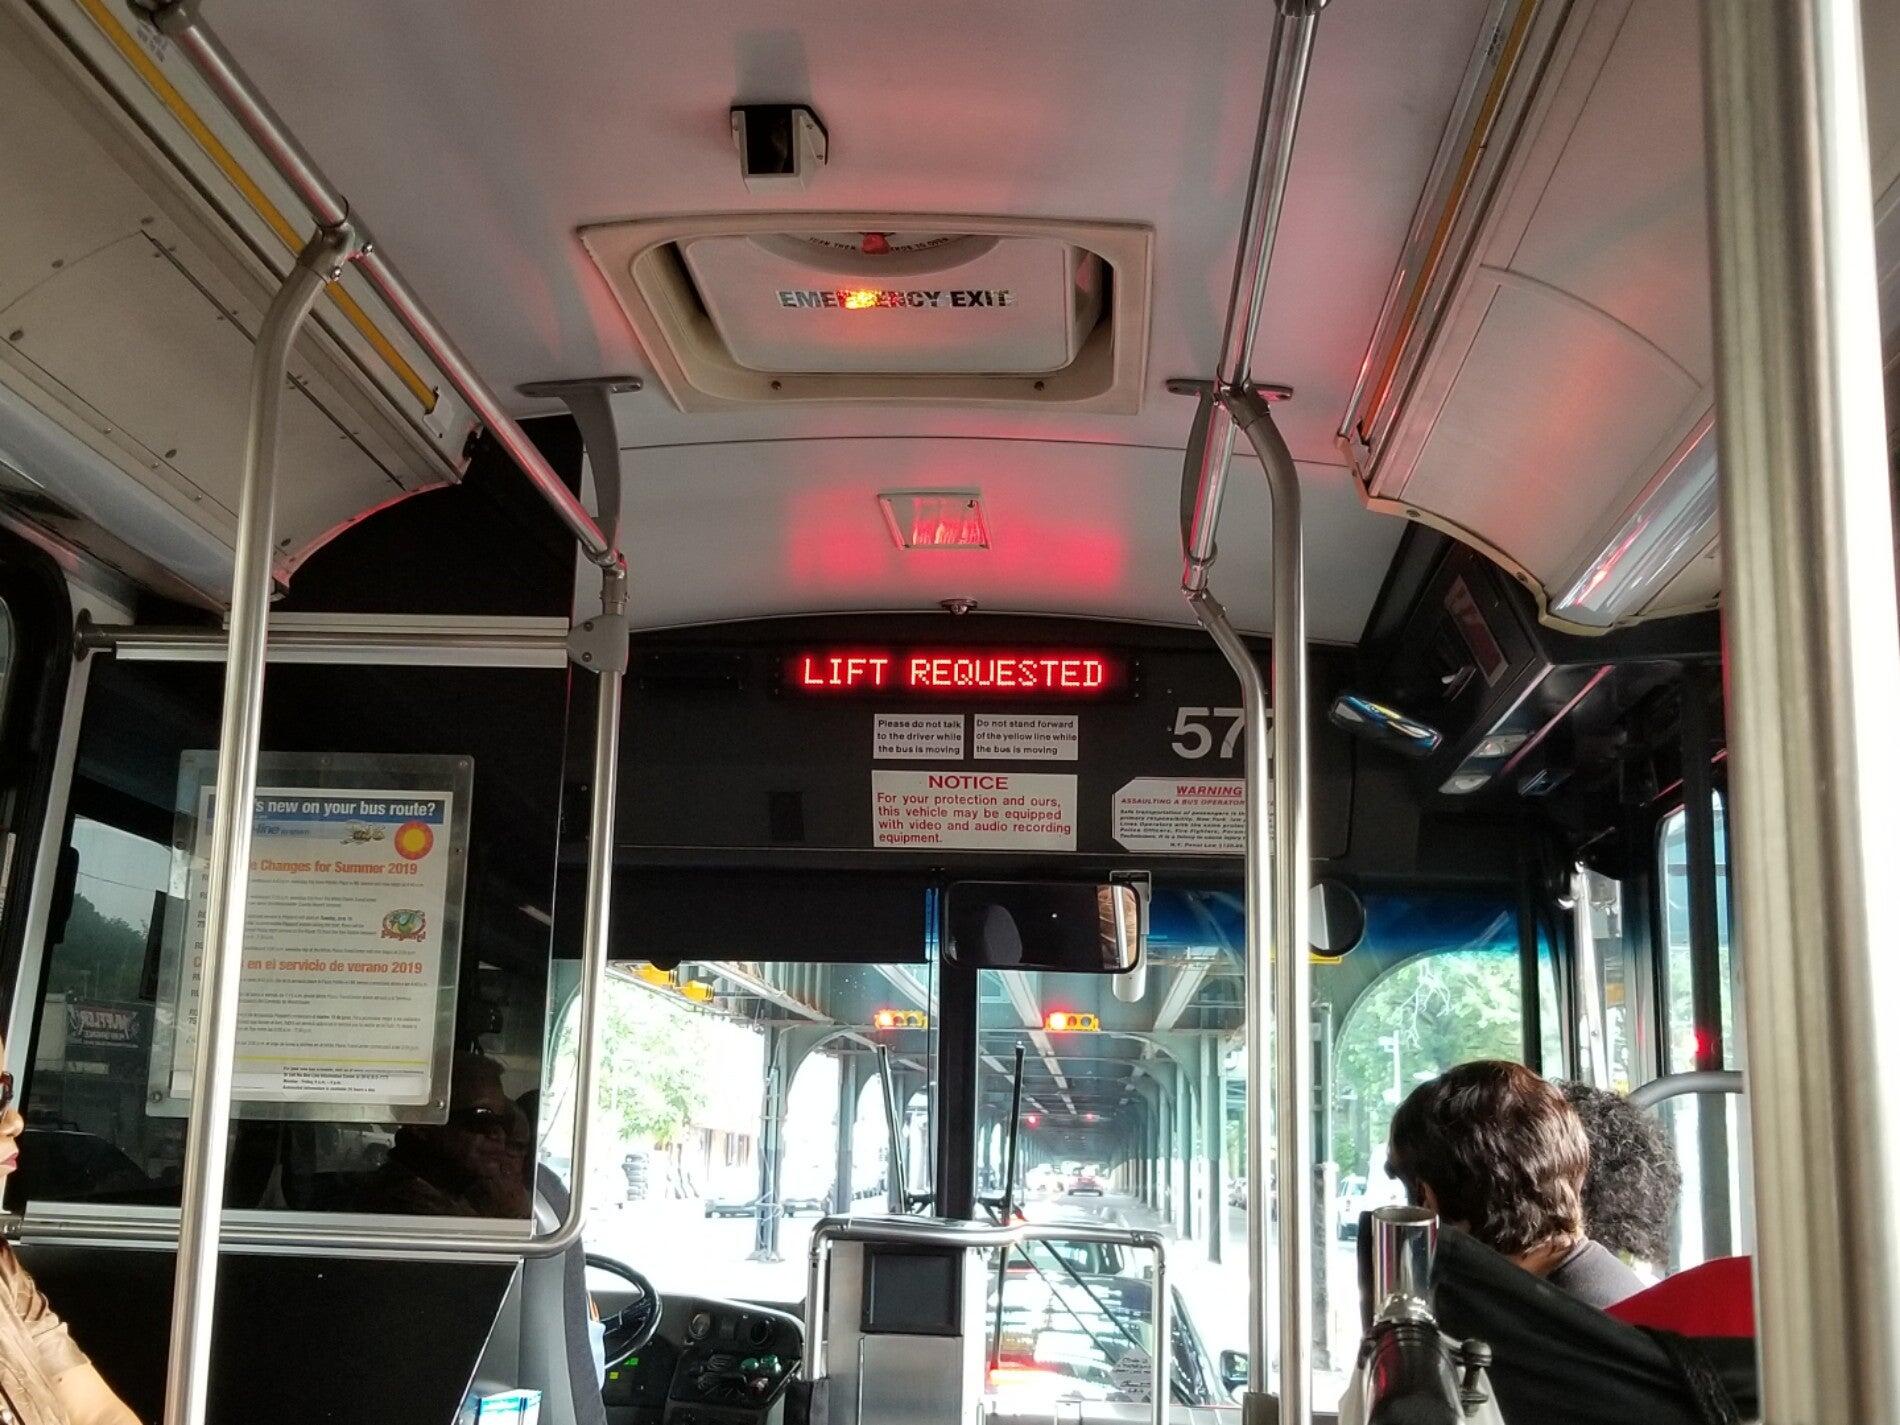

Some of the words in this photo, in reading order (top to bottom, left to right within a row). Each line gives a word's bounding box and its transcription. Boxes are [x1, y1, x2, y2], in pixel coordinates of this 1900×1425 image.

[779, 290, 941, 308] EMEENCY
[950, 289, 1009, 307] EXIT
[804, 658, 888, 686] LIFT
[910, 659, 1103, 687] REQUESTED
[878, 719, 910, 728] Please
[912, 720, 924, 728] do
[925, 720, 941, 728] not
[943, 720, 961, 728] talk
[976, 719, 989, 727] Do
[991, 720, 1007, 728] not
[1008, 720, 1035, 728] stand
[1038, 720, 1074, 728] forward
[877, 732, 887, 740] to
[889, 732, 905, 740] the
[906, 732, 935, 740] driver
[937, 733, 962, 741] while
[976, 732, 985, 740] of
[986, 732, 1002, 740] the
[1003, 732, 1032, 742] yellow
[1034, 733, 1051, 741] line
[1052, 733, 1077, 741] while
[878, 745, 894, 753] the
[895, 745, 914, 753] bus
[915, 745, 923, 753] is
[925, 745, 960, 755] moving
[976, 745, 992, 753] the
[994, 745, 1011, 753] bus
[1012, 745, 1021, 753] is
[1023, 746, 1058, 756] moving
[928, 775, 1009, 790] NOTICE
[1176, 786, 1243, 796] WARNING
[877, 792, 897, 803] For
[902, 794, 929, 806] your
[934, 793, 998, 807] protection
[1002, 795, 1025, 806] and
[1030, 797, 1061, 808] ours,
[267, 801, 299, 814] new
[302, 802, 320, 814] on
[324, 802, 356, 817] your
[360, 800, 386, 815] bus
[389, 802, 436, 816] route?
[878, 806, 900, 817] this
[905, 806, 948, 818] vehicle
[953, 808, 978, 820] may
[984, 808, 1000, 819] be
[1005, 809, 1062, 821] equipped
[878, 819, 904, 831] with
[909, 820, 942, 831] video
[947, 821, 969, 832] and
[974, 821, 1008, 832] audio
[1012, 822, 1071, 835] recording
[878, 832, 943, 844] equipment.
[260, 860, 311, 874] Changes
[314, 860, 331, 873] for
[335, 861, 386, 874] Summer
[388, 862, 418, 875] 2019
[247, 960, 262, 970] en
[265, 959, 277, 970] el
[280, 959, 326, 972] servicio
[329, 960, 345, 972] de
[347, 962, 389, 973] verano
[391, 961, 423, 974] 2019
